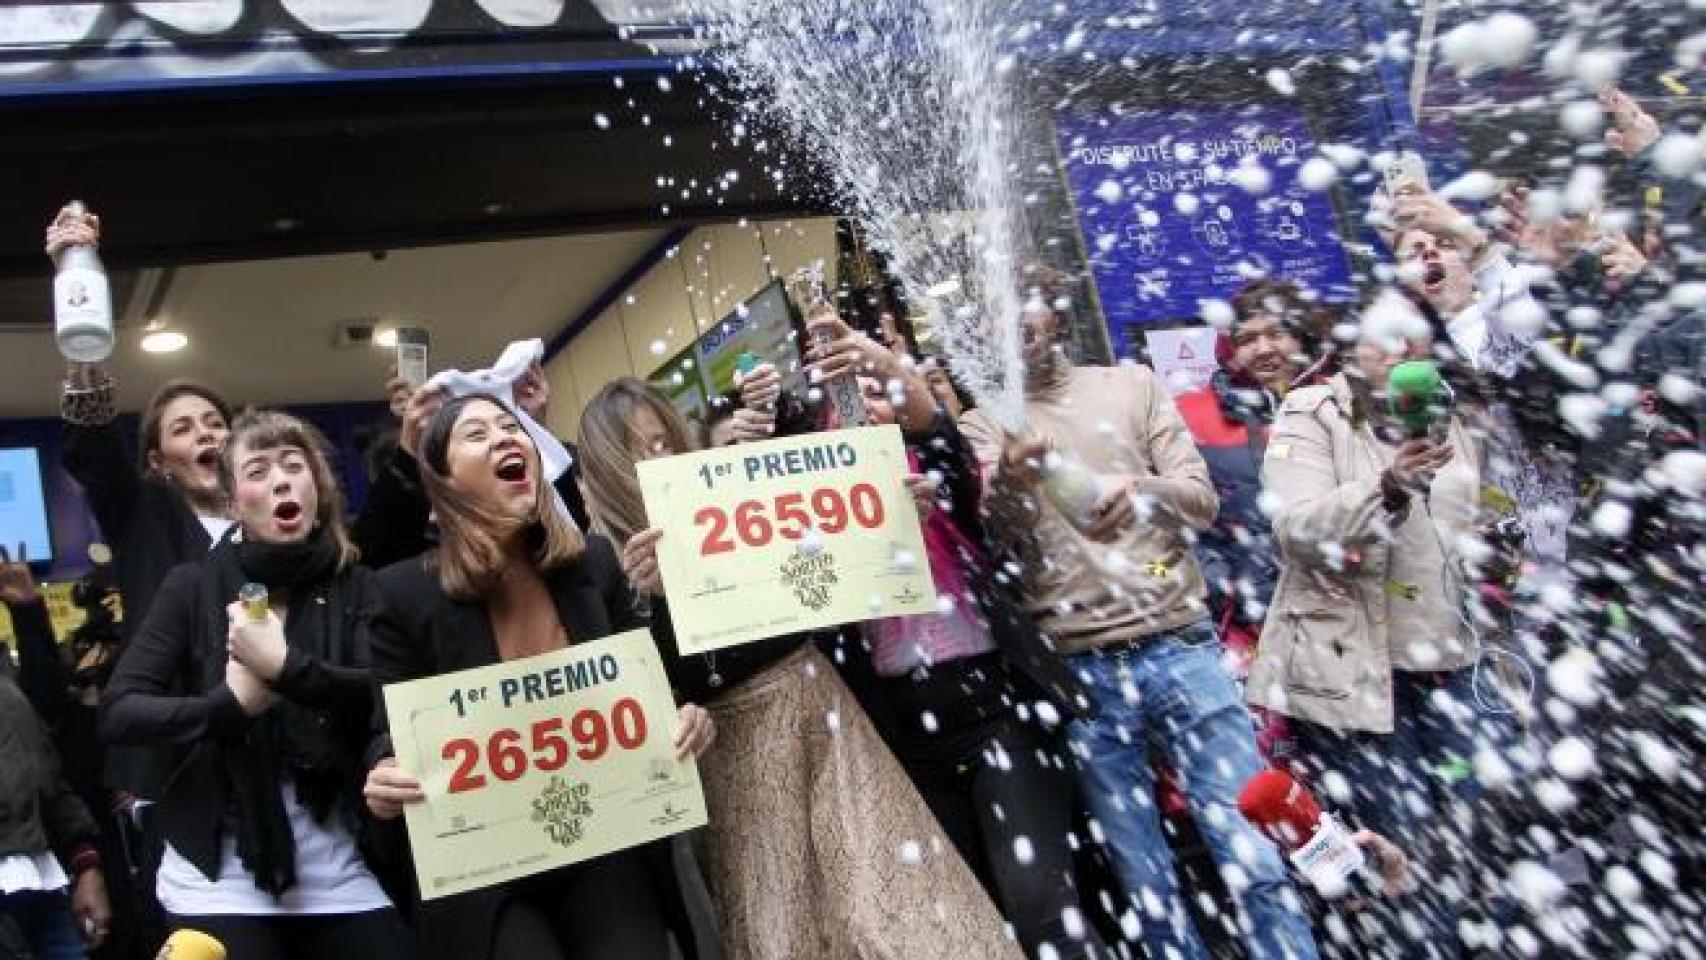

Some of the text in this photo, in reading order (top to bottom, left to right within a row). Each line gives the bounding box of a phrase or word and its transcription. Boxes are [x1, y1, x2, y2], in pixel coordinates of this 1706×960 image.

[1147, 171, 1174, 191] EN
[699, 442, 857, 488] 1er PREMIO
[693, 483, 886, 557] 26590
[449, 655, 618, 717] 1er PREMIO
[441, 697, 647, 793] 26590
